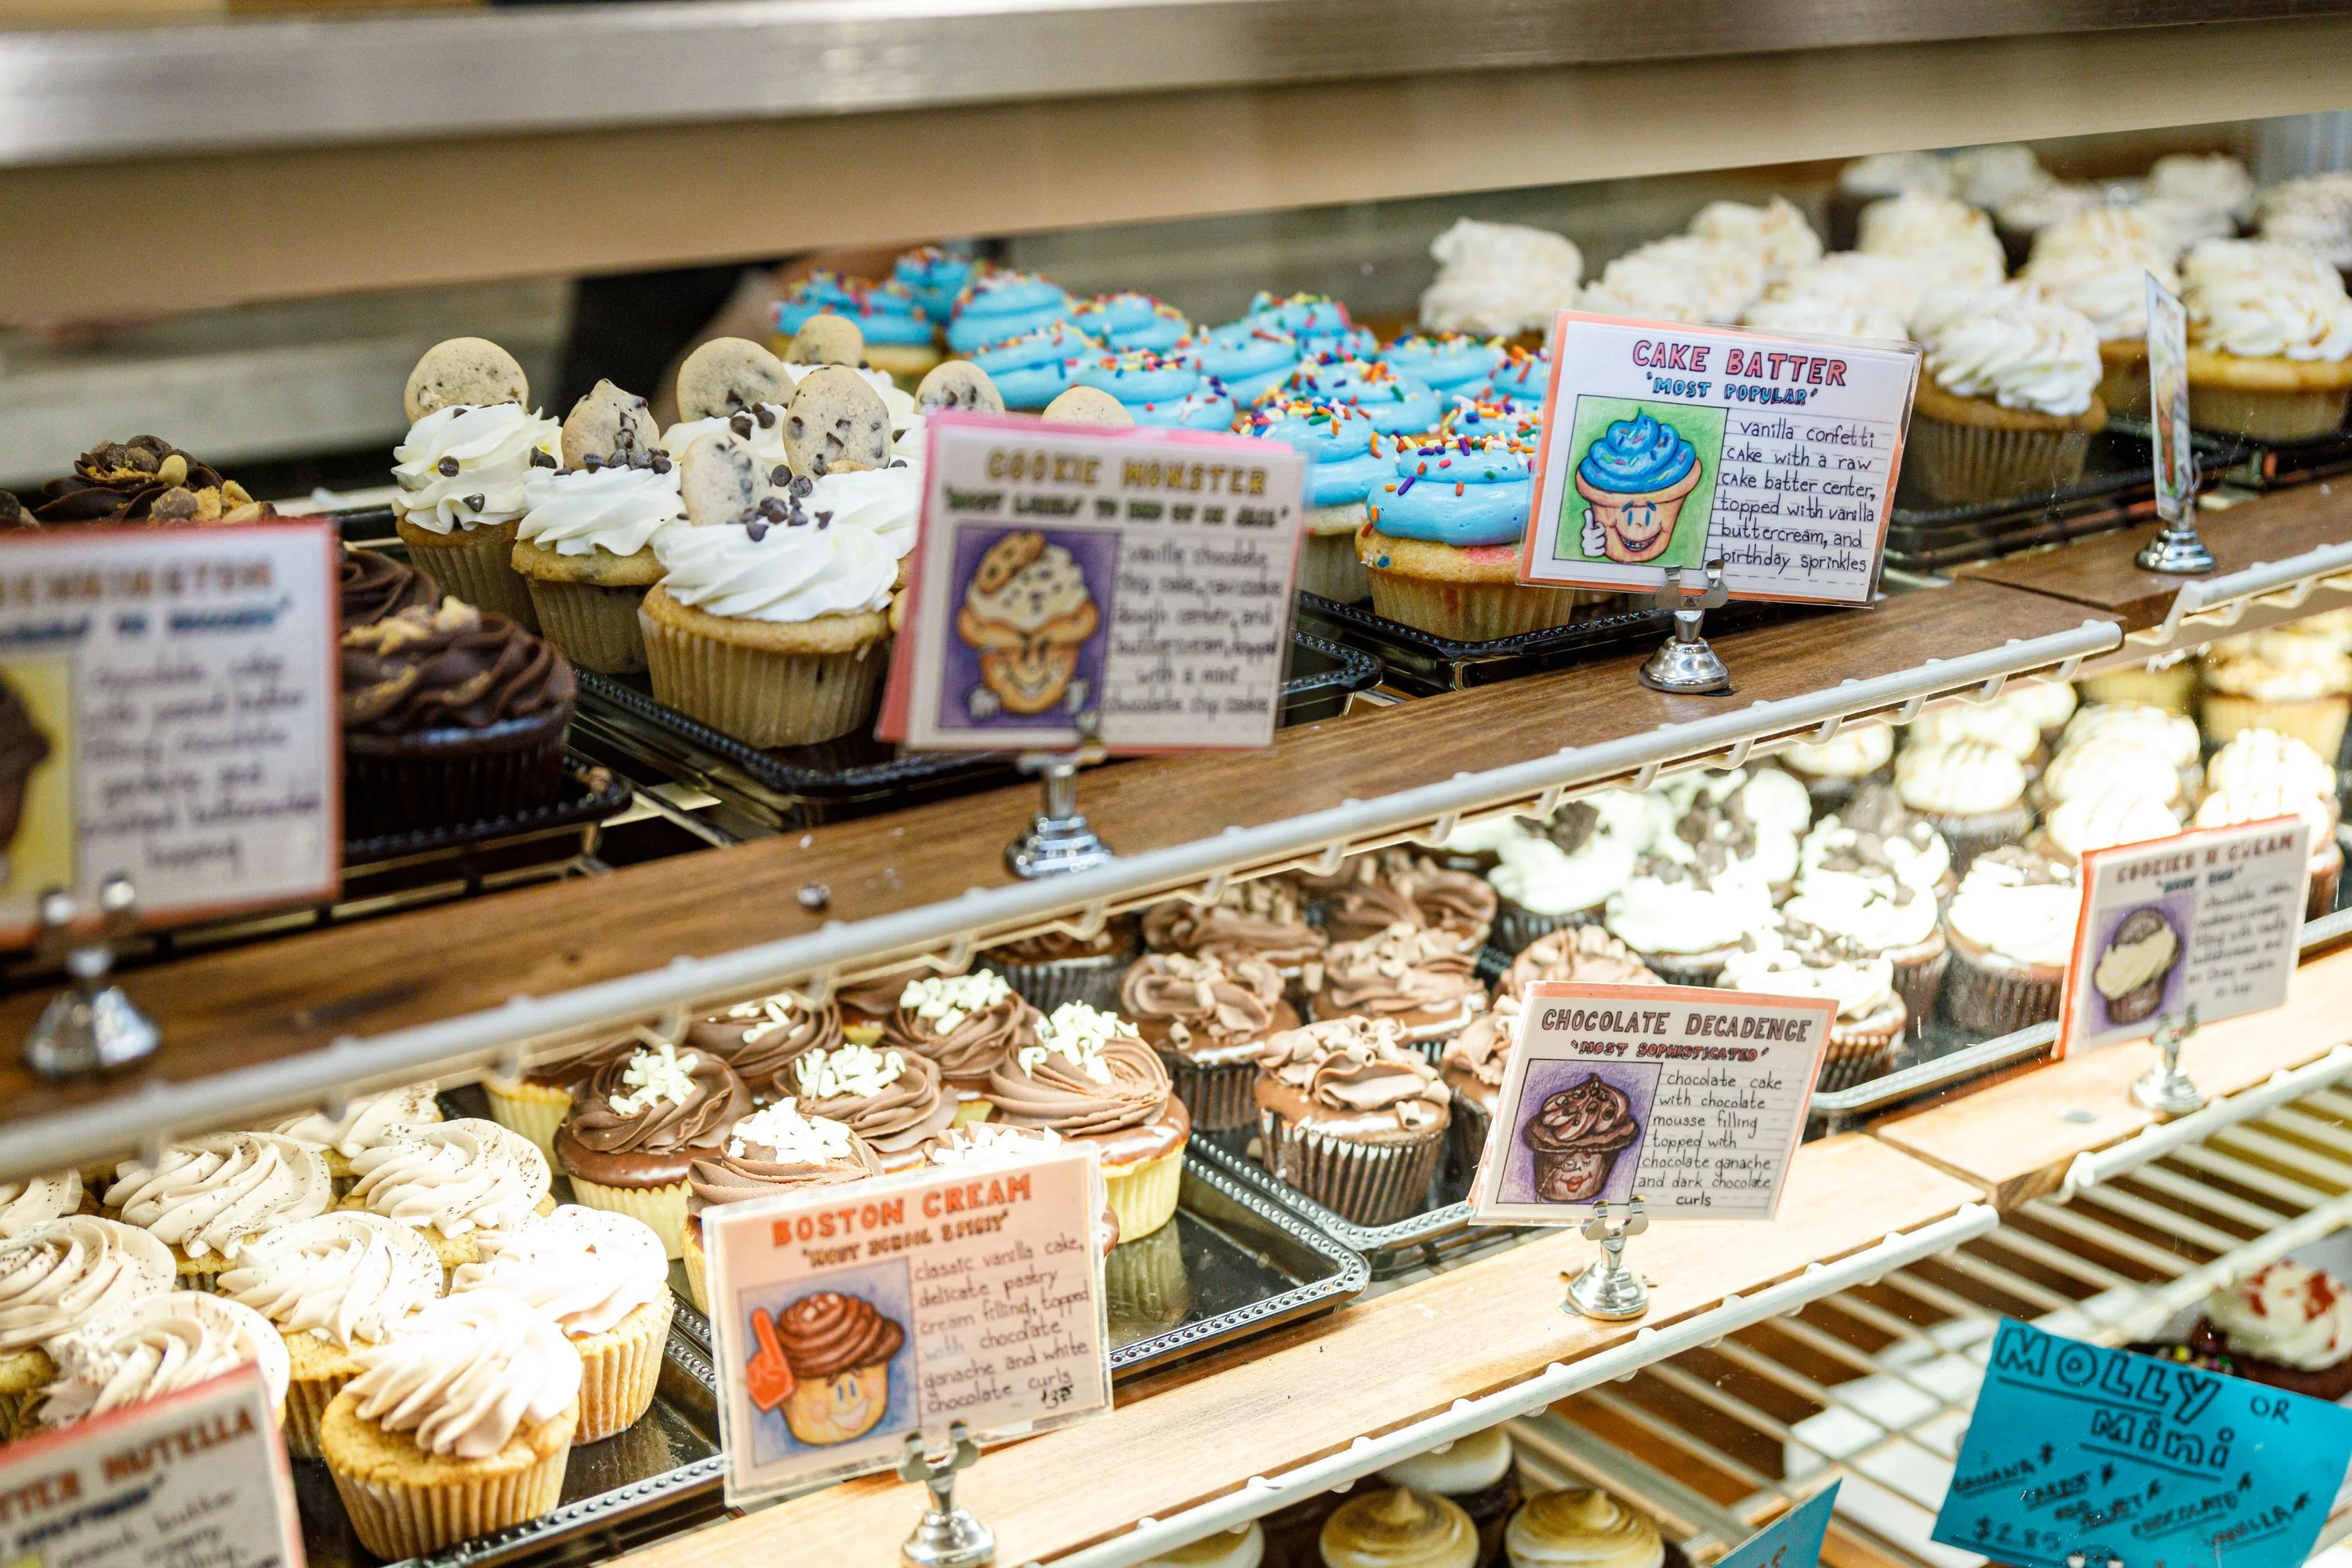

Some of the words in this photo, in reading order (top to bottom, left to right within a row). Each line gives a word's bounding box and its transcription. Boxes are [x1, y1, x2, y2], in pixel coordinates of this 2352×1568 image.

[1632, 339, 1711, 372] CAKE
[1725, 348, 1848, 387] BATTER
[1740, 417, 1794, 440] vanilla
[1806, 424, 1875, 448] confetti
[985, 448, 1101, 485] COOKIE
[1120, 456, 1269, 497] MONSTER
[1775, 444, 1809, 467] with
[1818, 455, 1827, 468] a
[1838, 458, 1872, 470] raw
[1765, 470, 1817, 492] batter
[1823, 475, 1876, 502] center,
[1721, 489, 1781, 522] topped
[1787, 495, 1823, 519] with
[1829, 501, 1875, 522] vanilla
[1721, 517, 1828, 550] buttercream,
[1834, 528, 1863, 548] and
[1720, 543, 1791, 575] birthday
[1801, 550, 1867, 576] sprinkles
[1541, 1009, 1671, 1035] CHOCOLATE
[1685, 1013, 1812, 1043] DECADENCE
[1667, 1067, 1737, 1087] chocolate
[1750, 1071, 1782, 1090] cake
[1660, 1087, 1691, 1106] with
[1700, 1089, 1766, 1109] chocolate
[1653, 1115, 1706, 1127] mousse
[1717, 1109, 1759, 1139] filling
[1653, 1129, 1704, 1154] topped
[1708, 1129, 1737, 1149] with
[1642, 1149, 1709, 1168] chocolate
[1715, 1154, 1771, 1176] ganache
[1638, 1171, 1665, 1188] and
[1671, 1170, 1702, 1188] dark
[1712, 1171, 1771, 1189] chocolate
[771, 1198, 905, 1247] BOSTON
[922, 1173, 1032, 1218] CREAM
[1676, 1191, 1711, 1206] curls
[915, 1259, 975, 1282] classic
[982, 1240, 1034, 1268] vanilla
[919, 1274, 991, 1308] delicate
[1004, 1263, 1058, 1300] pastry
[920, 1314, 976, 1334] cream
[1041, 1279, 1090, 1318] topped
[980, 1313, 1062, 1349] chocolate
[924, 1357, 996, 1398] ganache
[1005, 1343, 1039, 1370] and
[1043, 1330, 1090, 1363] white
[1994, 1327, 2222, 1425] MOLLY
[2250, 1395, 2292, 1425] OR
[927, 1379, 1013, 1413] chocolate
[1028, 1367, 1073, 1390] curls
[101, 1408, 255, 1486] NUTELLA
